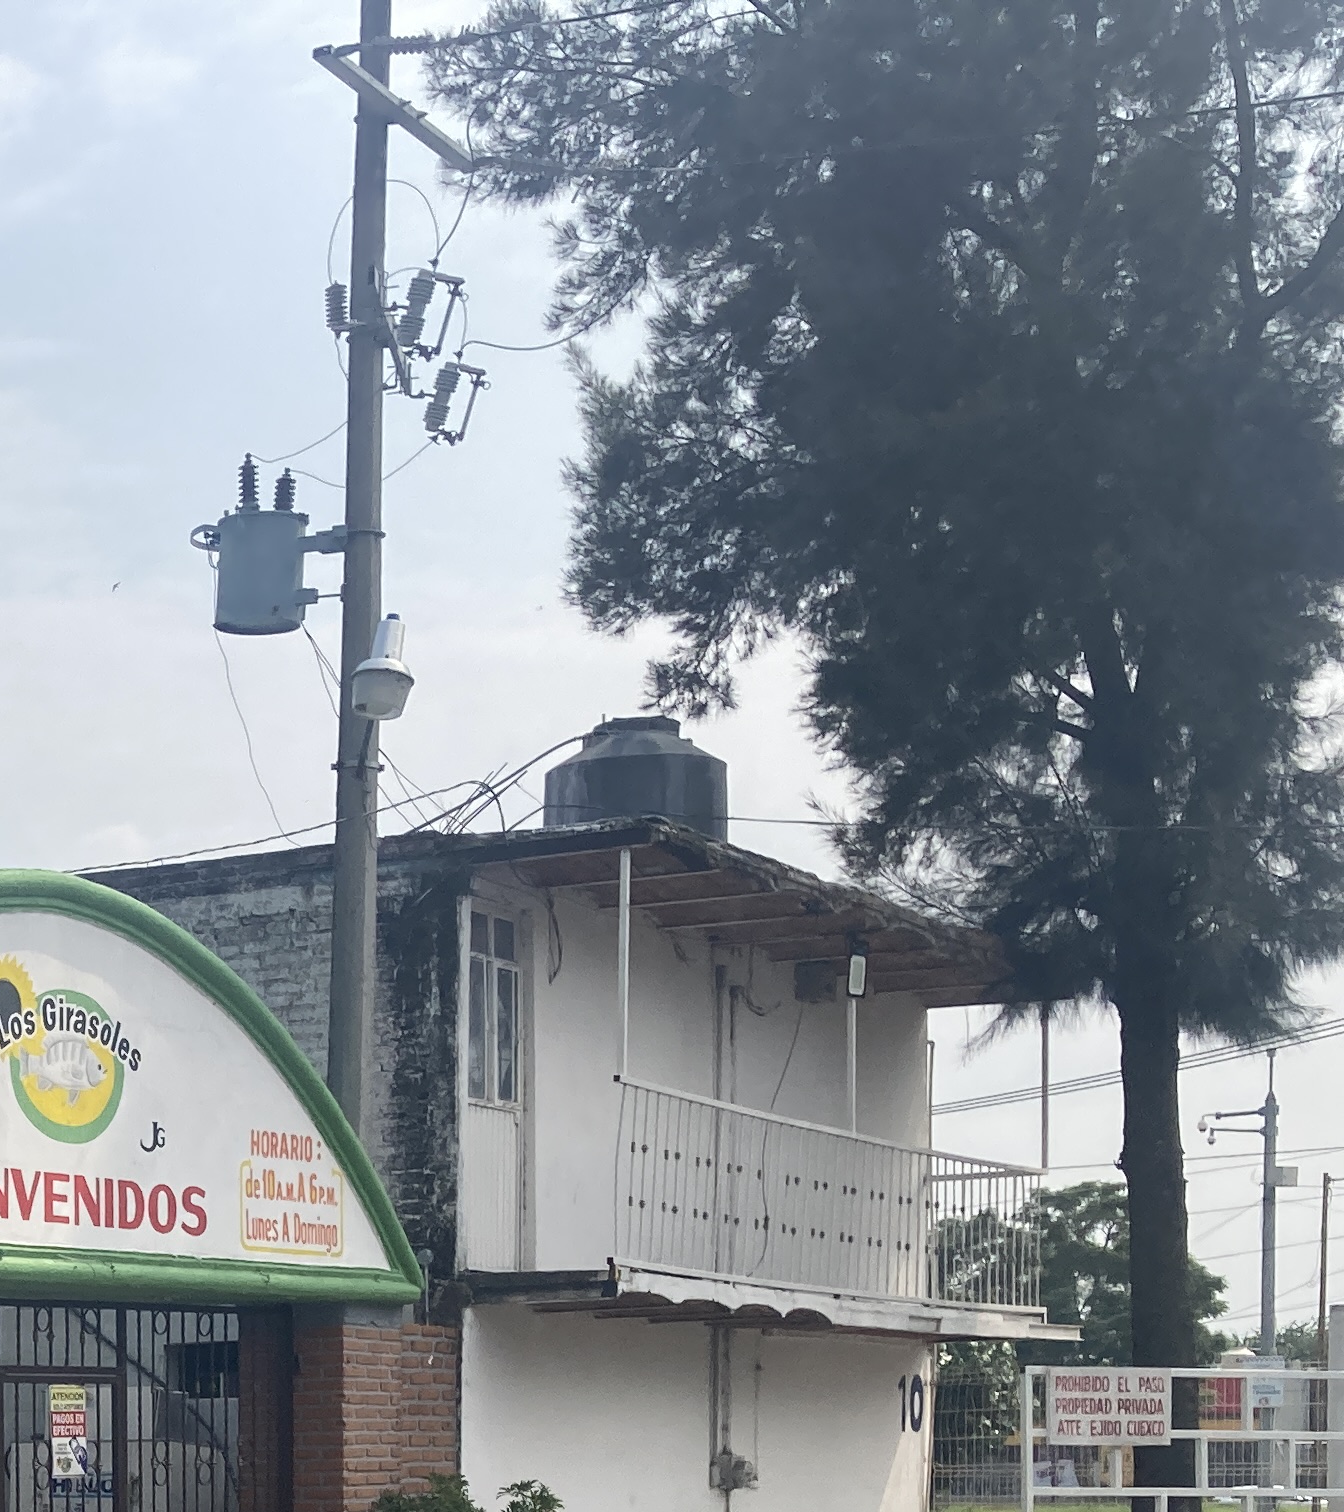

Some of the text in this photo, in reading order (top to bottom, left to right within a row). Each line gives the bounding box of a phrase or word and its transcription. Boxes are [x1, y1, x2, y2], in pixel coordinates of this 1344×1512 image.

[42, 997, 142, 1072] Girasoles
[245, 1208, 338, 1253] Lunes A Domingo
[1055, 1375, 1165, 1394] PROHIBIDO EL PASO
[898, 1374, 923, 1432] 10
[1055, 1397, 1164, 1416] PROPIEDAD PRIVADA
[52, 1413, 85, 1424] PAGOS EN
[1090, 1419, 1122, 1437] EJIDO
[52, 1425, 85, 1436] EFECTIVO
